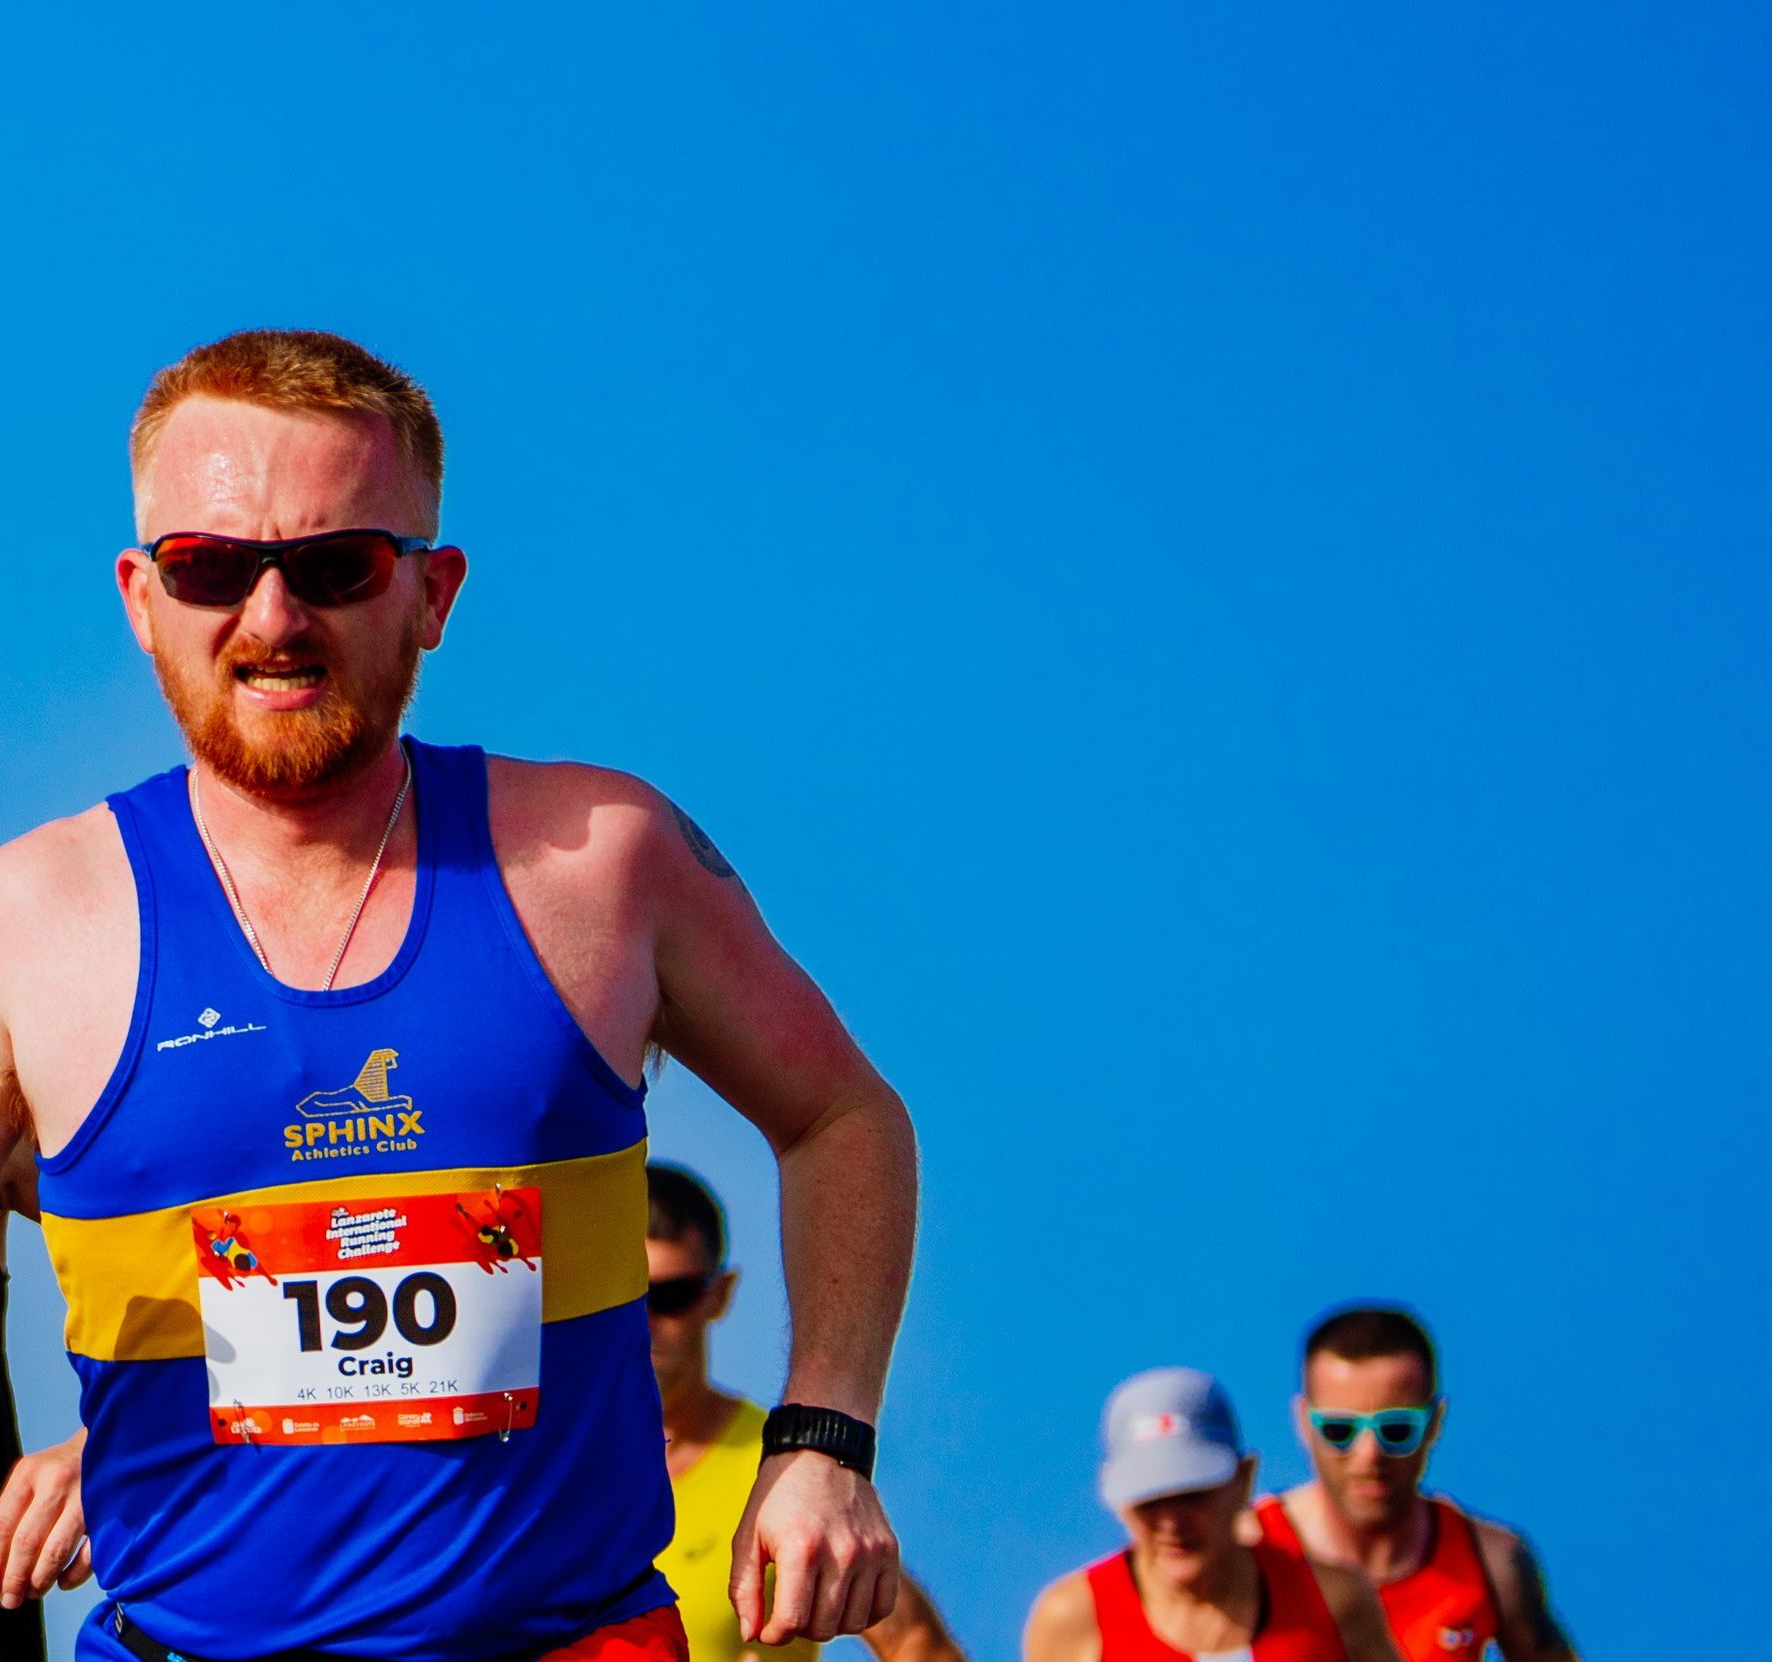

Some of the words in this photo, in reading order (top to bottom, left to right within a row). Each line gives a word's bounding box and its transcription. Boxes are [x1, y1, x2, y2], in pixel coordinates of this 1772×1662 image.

[157, 1022, 267, 1052] RONHILL
[283, 1110, 425, 1148] SPHINX
[291, 1145, 370, 1162] Athletics
[376, 1138, 418, 1152] Club
[326, 1214, 407, 1240] International
[341, 1230, 396, 1249] Running
[337, 1241, 401, 1260] Challenge
[282, 1270, 457, 1352] 190
[337, 1351, 414, 1379] Craig
[297, 1387, 317, 1400] 4K
[326, 1385, 354, 1399] 10K
[365, 1384, 391, 1397] 13K
[400, 1381, 421, 1395] 5K
[429, 1379, 459, 1394] 21K
